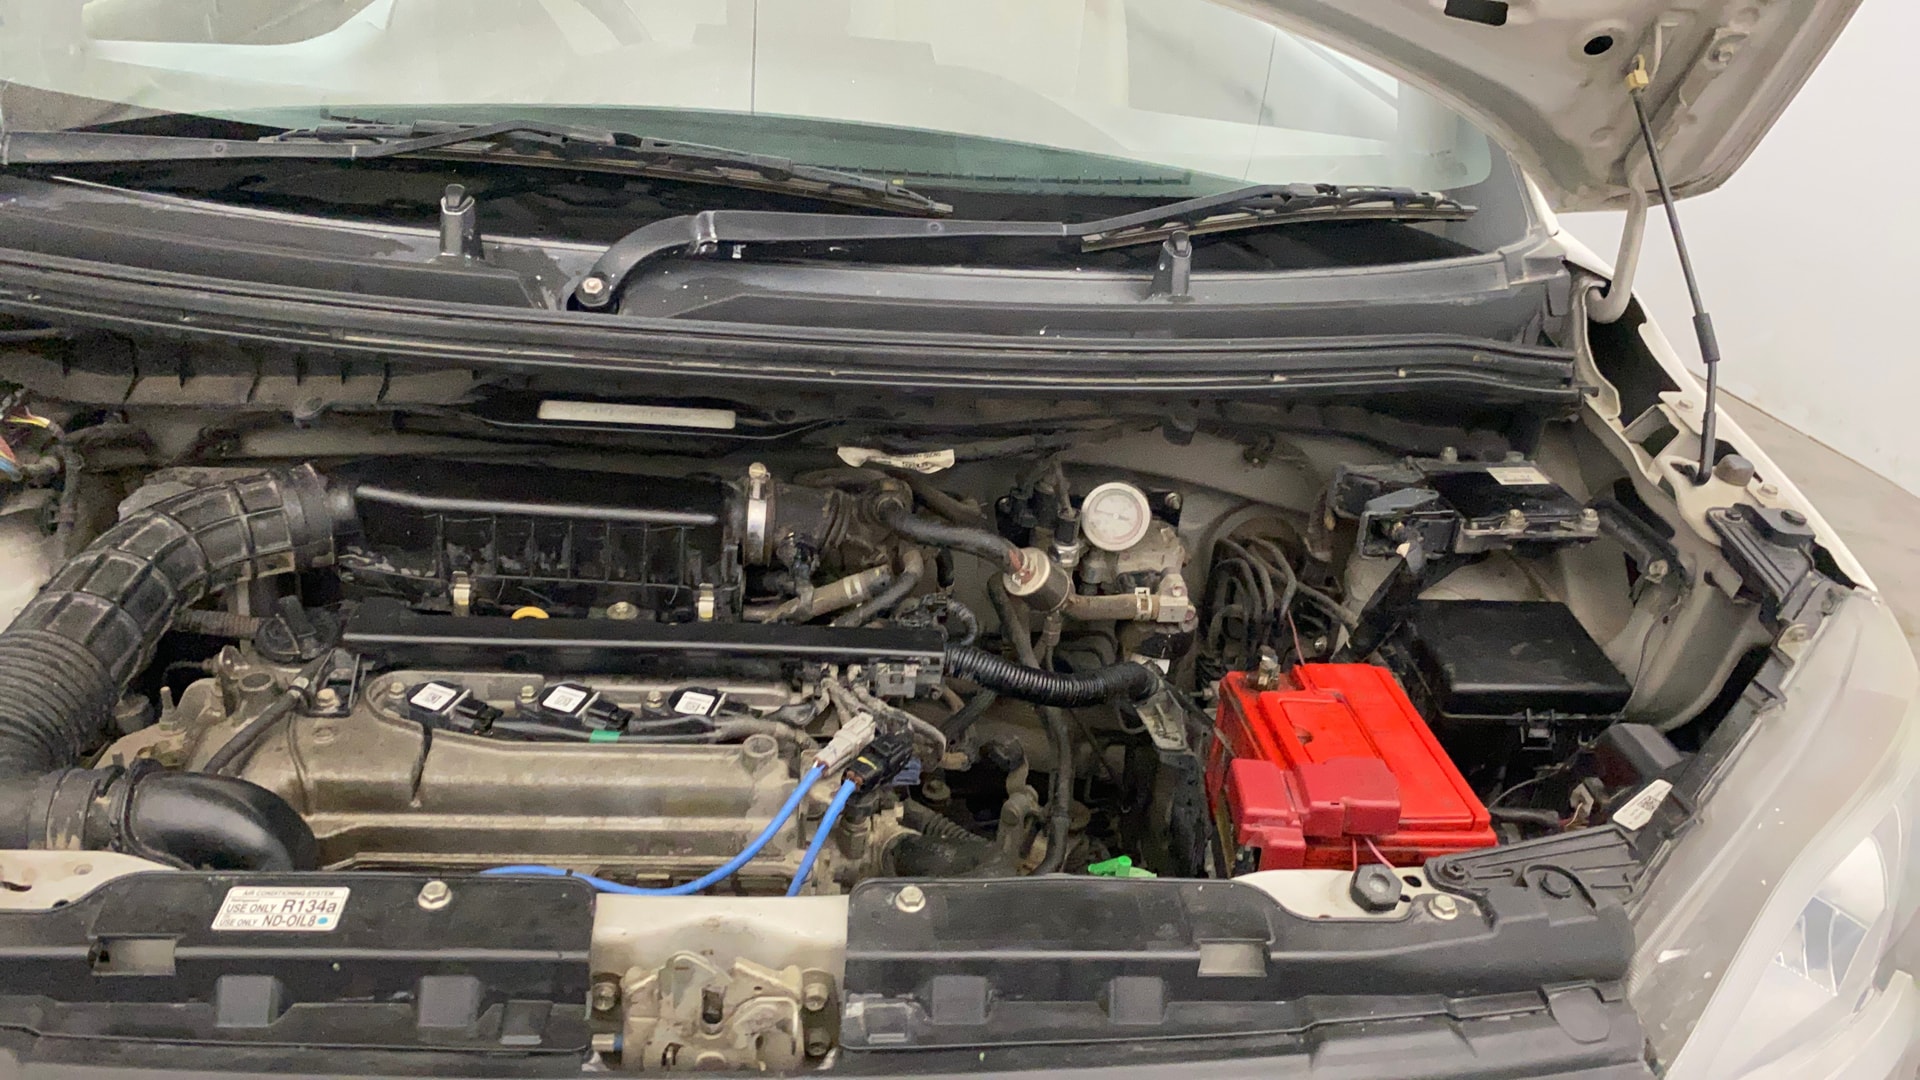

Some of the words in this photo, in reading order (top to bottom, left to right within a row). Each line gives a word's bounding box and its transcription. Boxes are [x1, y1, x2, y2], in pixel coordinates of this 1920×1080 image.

[226, 903, 246, 913] USE
[249, 903, 277, 913] ONLY
[281, 899, 338, 913] R134a
[219, 918, 236, 927] USE
[237, 918, 258, 927] ONLY
[262, 915, 317, 927] ND-OIL8
